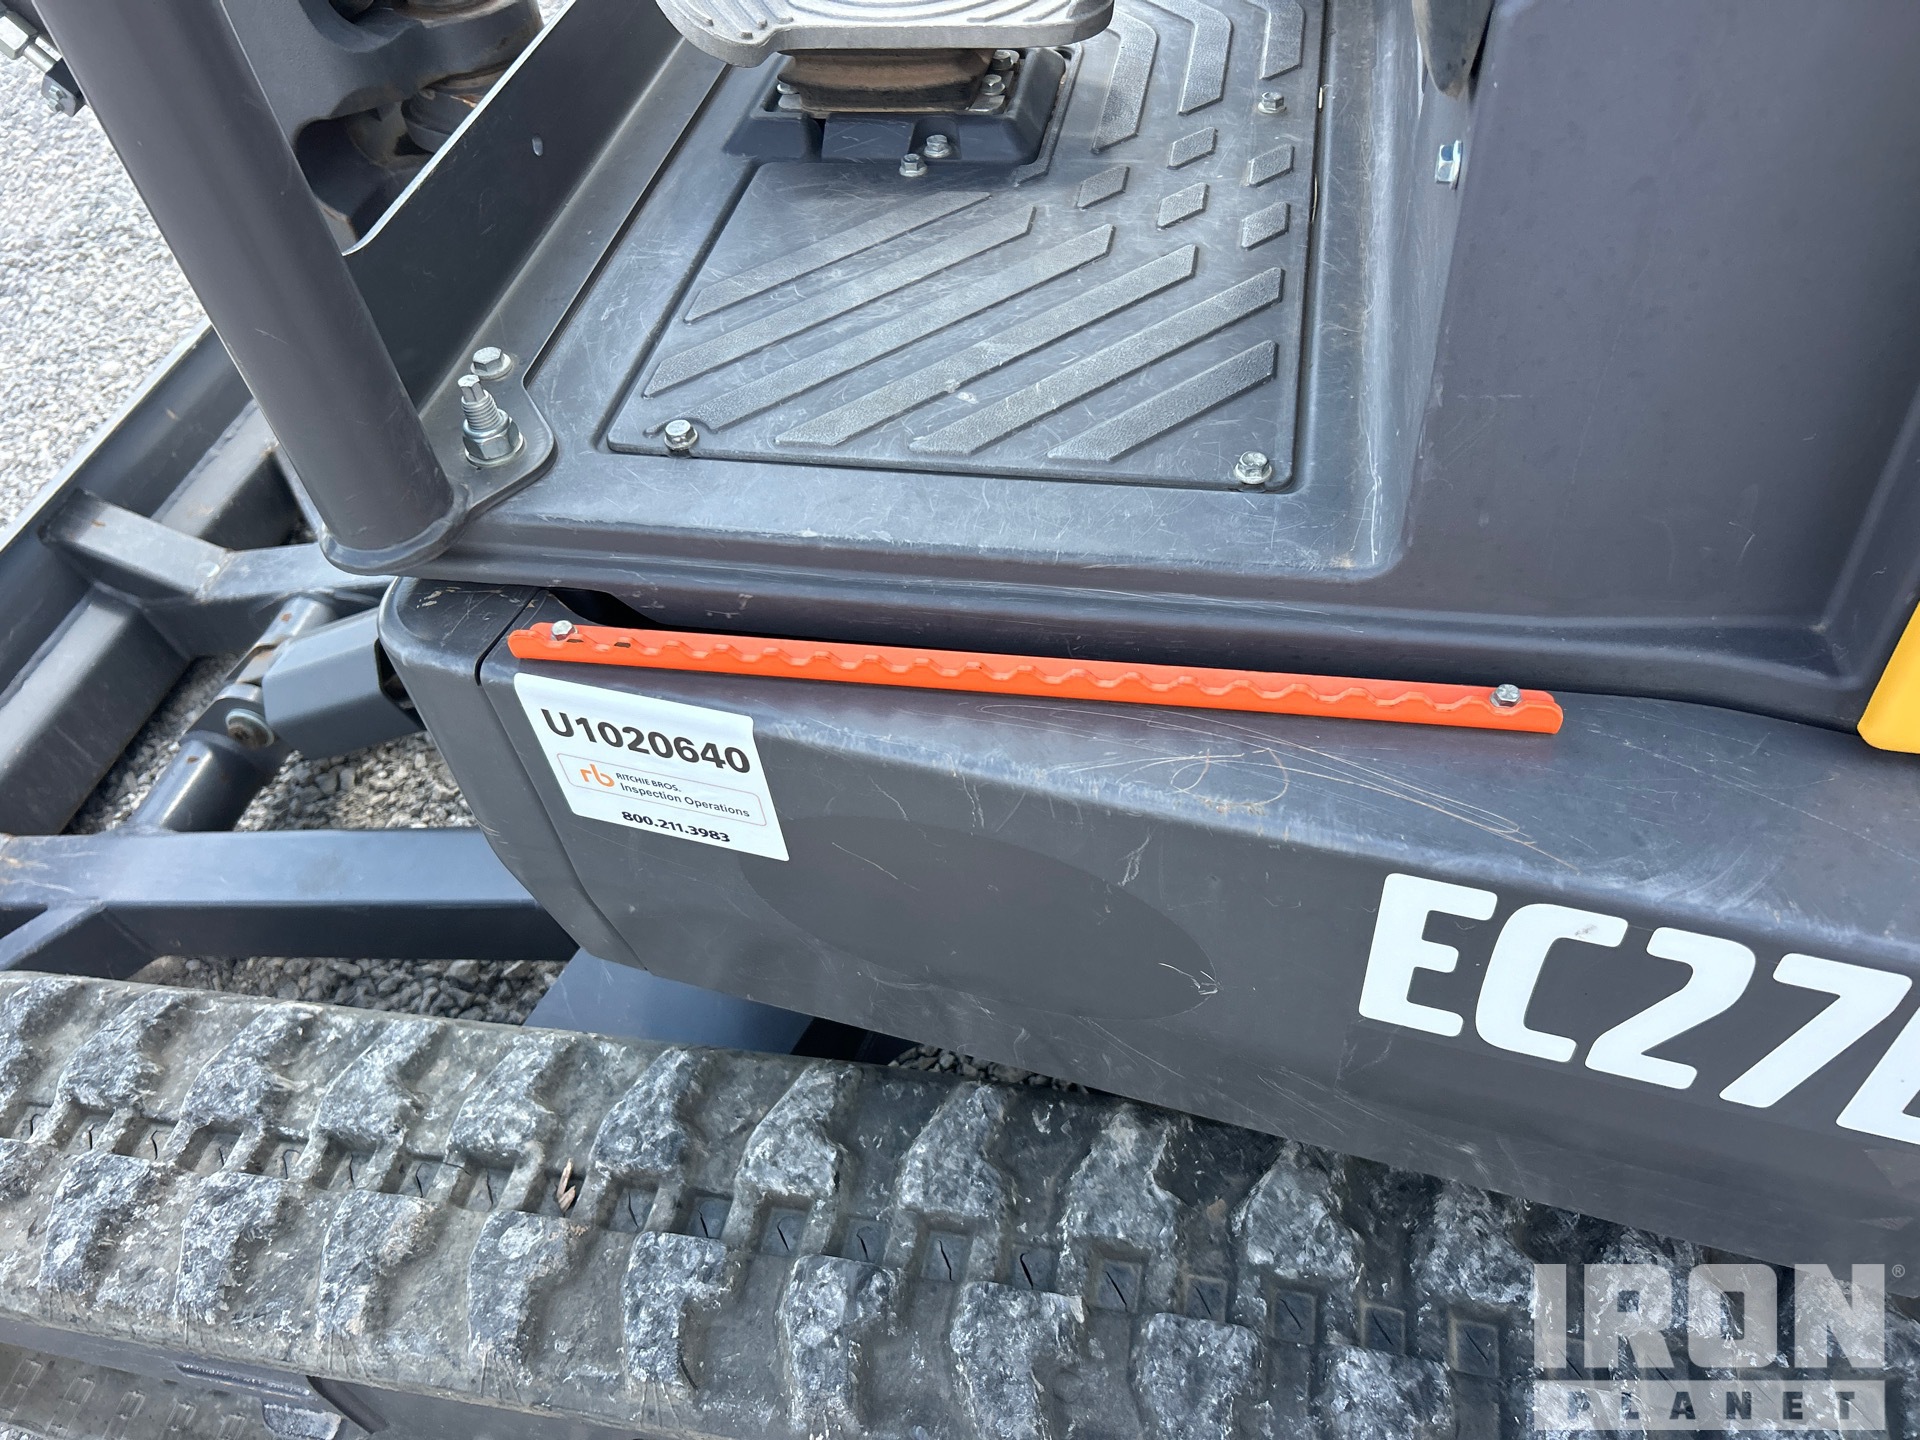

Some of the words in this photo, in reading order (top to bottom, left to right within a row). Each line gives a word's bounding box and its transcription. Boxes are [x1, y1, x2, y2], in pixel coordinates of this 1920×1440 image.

[541, 709, 750, 773] U1020640
[580, 764, 615, 787] rb
[616, 772, 650, 786] RITCHIE
[651, 780, 682, 792] BROS.
[620, 783, 682, 803] Inspection
[684, 797, 750, 817] Operations
[621, 811, 731, 842] 800.211.3983
